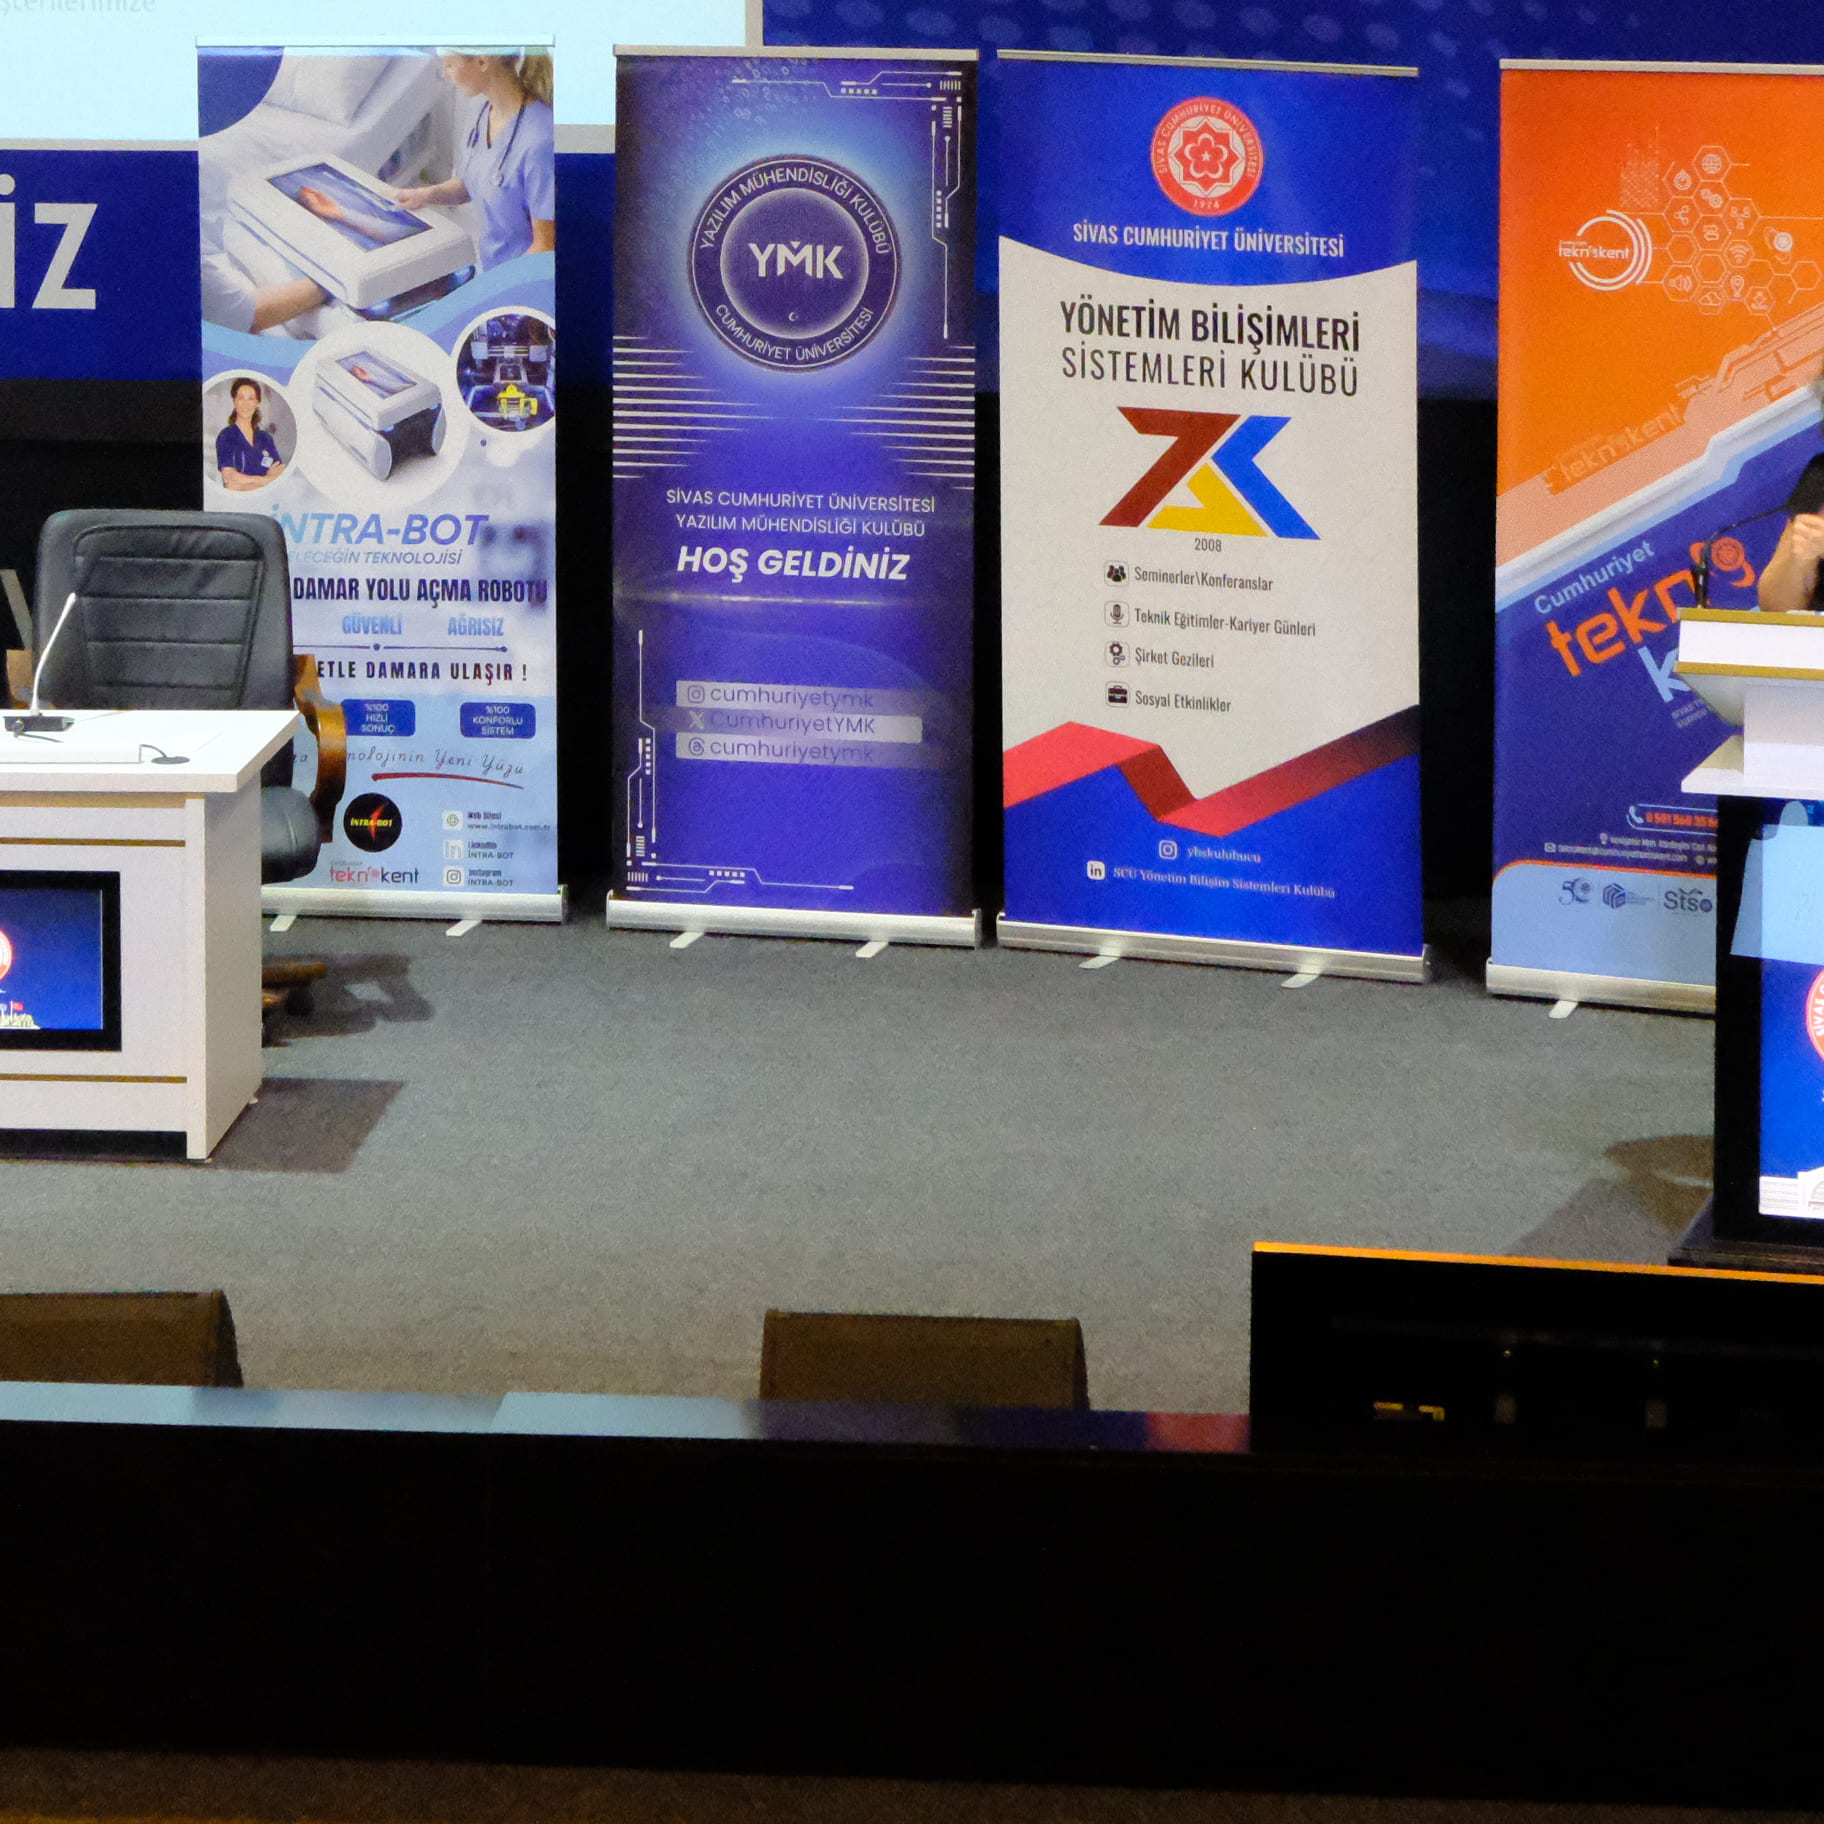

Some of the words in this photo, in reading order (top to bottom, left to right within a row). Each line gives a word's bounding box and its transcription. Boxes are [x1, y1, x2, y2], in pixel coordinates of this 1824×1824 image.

[699, 184, 741, 250] YAZILIM
[739, 166, 853, 200] MÜHENDİSLİĞİ
[850, 192, 892, 256] KULÜBÜ
[1072, 218, 1119, 245] SİVAS
[1122, 224, 1229, 251] CUMHURİYET
[1234, 227, 1345, 258] ÜNİVERSİTESİ
[748, 240, 845, 280] YMK
[714, 302, 793, 362] CUMHURİYET
[795, 305, 875, 362] ÜNİVERSİTESİ
[1059, 294, 1181, 341] YÖNETİM
[1191, 302, 1361, 355] BİLİŞİMLERİ
[1061, 341, 1227, 389] SİSTEMLERİ
[1240, 354, 1359, 398] KULÜBÜ
[666, 487, 714, 506] SİVAS
[717, 488, 824, 510] CUMHURİYET
[828, 491, 936, 513] ÜNİVERSİTESİ
[675, 513, 737, 531] YAZILIM
[741, 514, 857, 535] MÜHENDİSLİĞİ
[861, 518, 926, 538] KULÜBÜ
[287, 547, 359, 564] ELECEĞİN
[364, 548, 463, 565] TEKNOLOJİSİ
[1193, 537, 1223, 553] 2008
[676, 545, 749, 584] HOŞ
[757, 544, 911, 581] GELDİNİZ
[1533, 539, 1657, 616] Cumhuriyet
[293, 577, 360, 601] DAMAR
[366, 578, 411, 602] YOLU
[417, 578, 472, 609] AÇMA
[478, 579, 548, 603] ROBOTU
[342, 611, 403, 634] GÜVENLİ
[448, 613, 504, 636] AĞRISIZ
[1134, 608, 1171, 626] Teknik
[1273, 619, 1316, 637] Günleri
[1135, 647, 1168, 666] Şirket
[1171, 651, 1215, 669] Gezileri
[317, 661, 356, 679] ETLE
[366, 661, 441, 679] DAMARA
[450, 662, 514, 686] ULAŞIR
[365, 703, 389, 712] %100
[485, 705, 510, 715] %100
[709, 686, 875, 710] cumhuriyetymk
[1135, 690, 1171, 709] Sosyal
[1174, 694, 1232, 713] Etkinlikler
[361, 724, 396, 734] SONUÇ
[472, 716, 524, 725] KONFORLU
[481, 725, 515, 736] SİSTEM
[709, 711, 876, 736] CumhuriyetYMK
[346, 745, 425, 768] nolojinin
[709, 737, 875, 763] cumhuriyetymk
